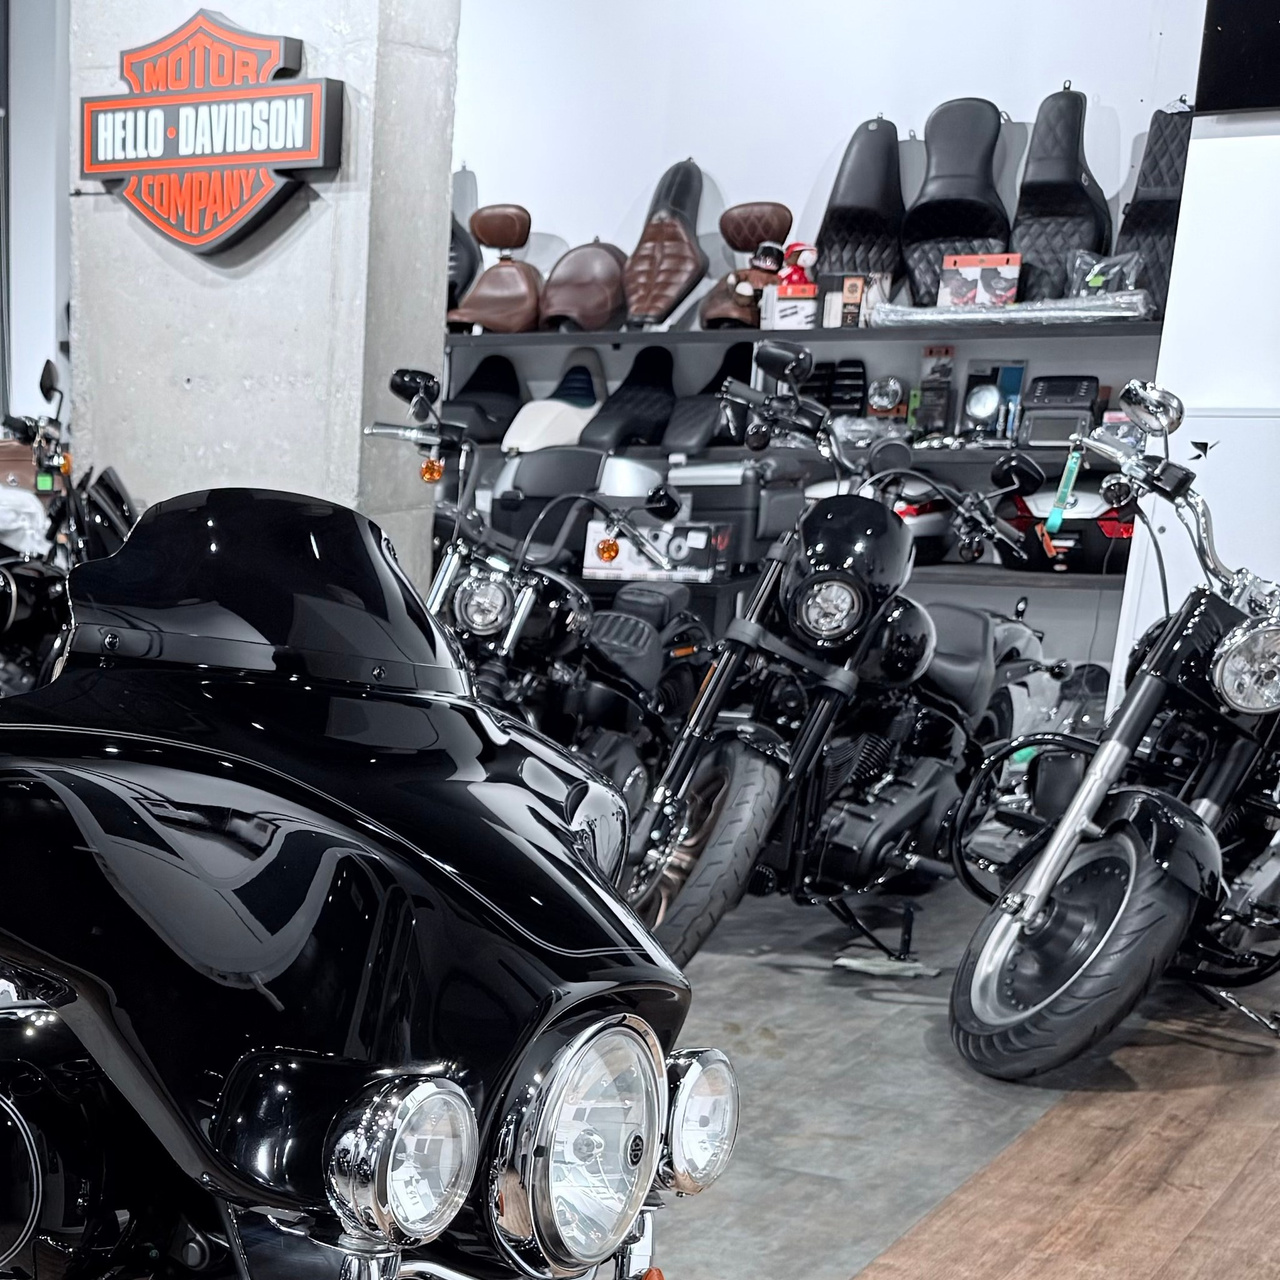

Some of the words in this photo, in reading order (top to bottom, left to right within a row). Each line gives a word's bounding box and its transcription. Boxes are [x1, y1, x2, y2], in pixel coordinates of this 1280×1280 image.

[143, 32, 258, 93] MOTOR
[97, 108, 165, 161] HELLO
[178, 98, 305, 156] DAVIDSON
[141, 168, 257, 234] COMPANY
